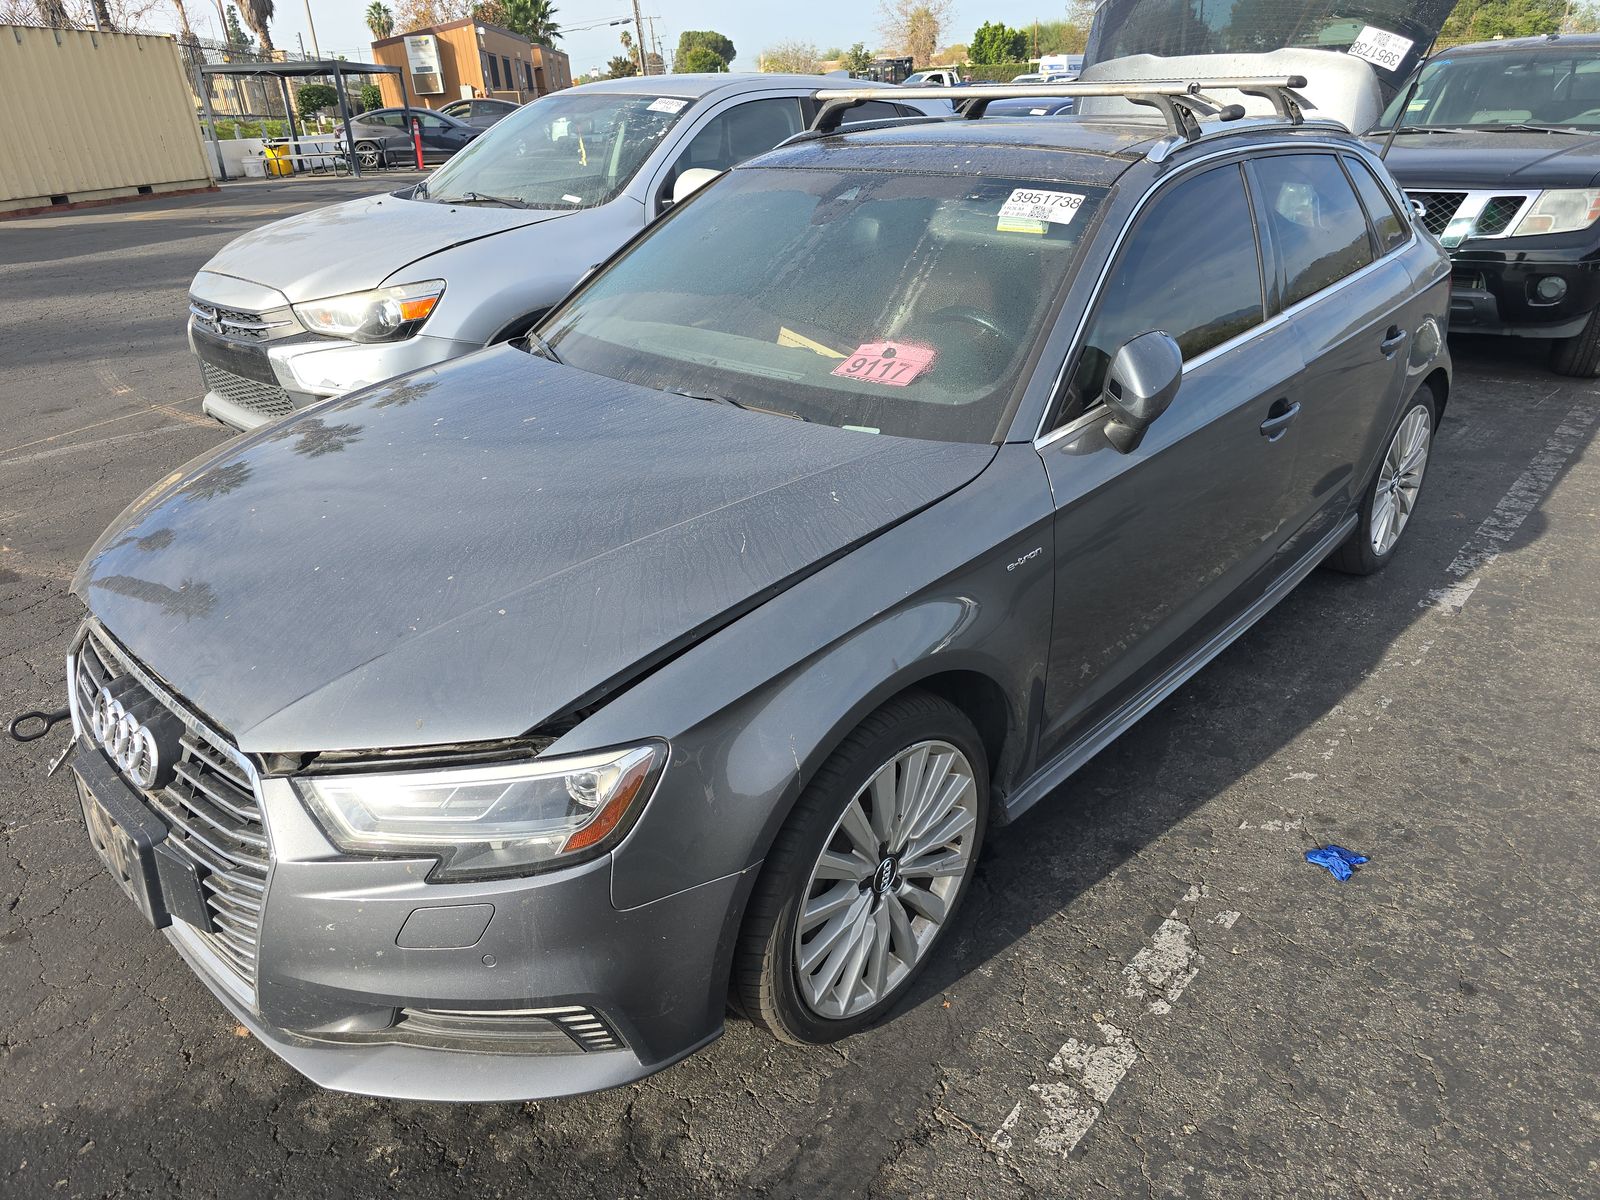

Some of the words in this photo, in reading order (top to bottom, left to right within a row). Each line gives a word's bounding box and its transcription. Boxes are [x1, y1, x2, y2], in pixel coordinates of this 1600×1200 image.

[1350, 41, 1400, 66] 3951738
[1011, 191, 1082, 209] 3951738
[846, 357, 913, 380] 9117
[1006, 547, 1042, 571] e-tron
